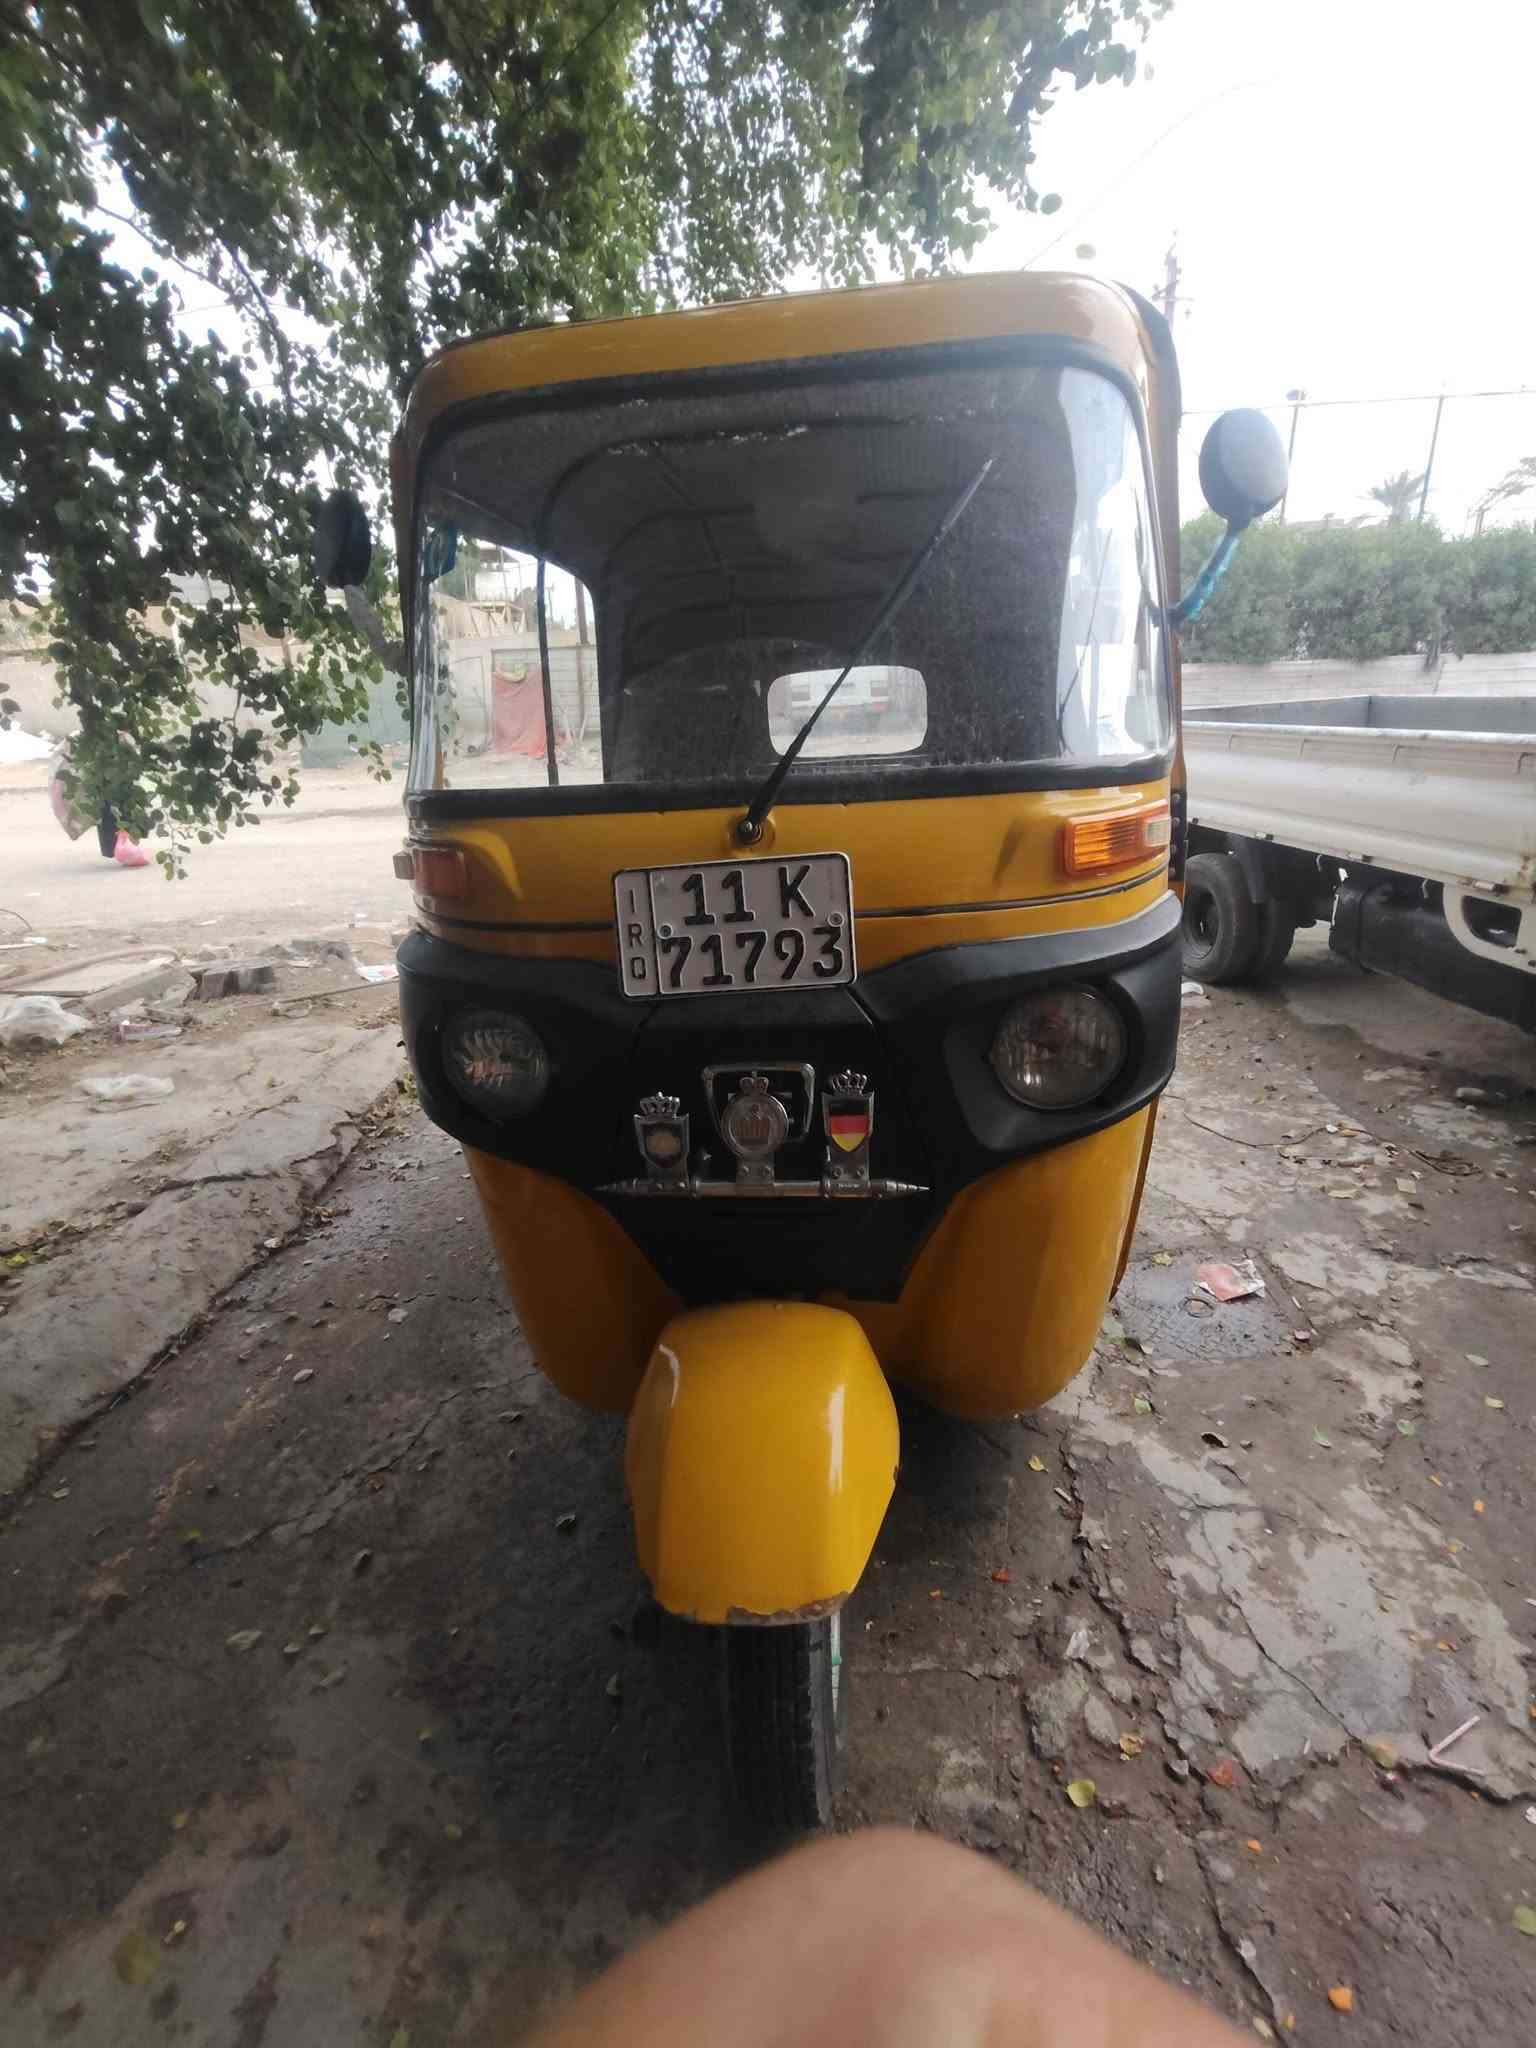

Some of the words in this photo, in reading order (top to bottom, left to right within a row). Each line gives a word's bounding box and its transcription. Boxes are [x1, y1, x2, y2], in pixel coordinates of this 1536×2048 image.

[682, 869, 755, 926] 11
[778, 864, 815, 919] K
[627, 889, 647, 980] IRQ
[661, 926, 844, 988] 71793
